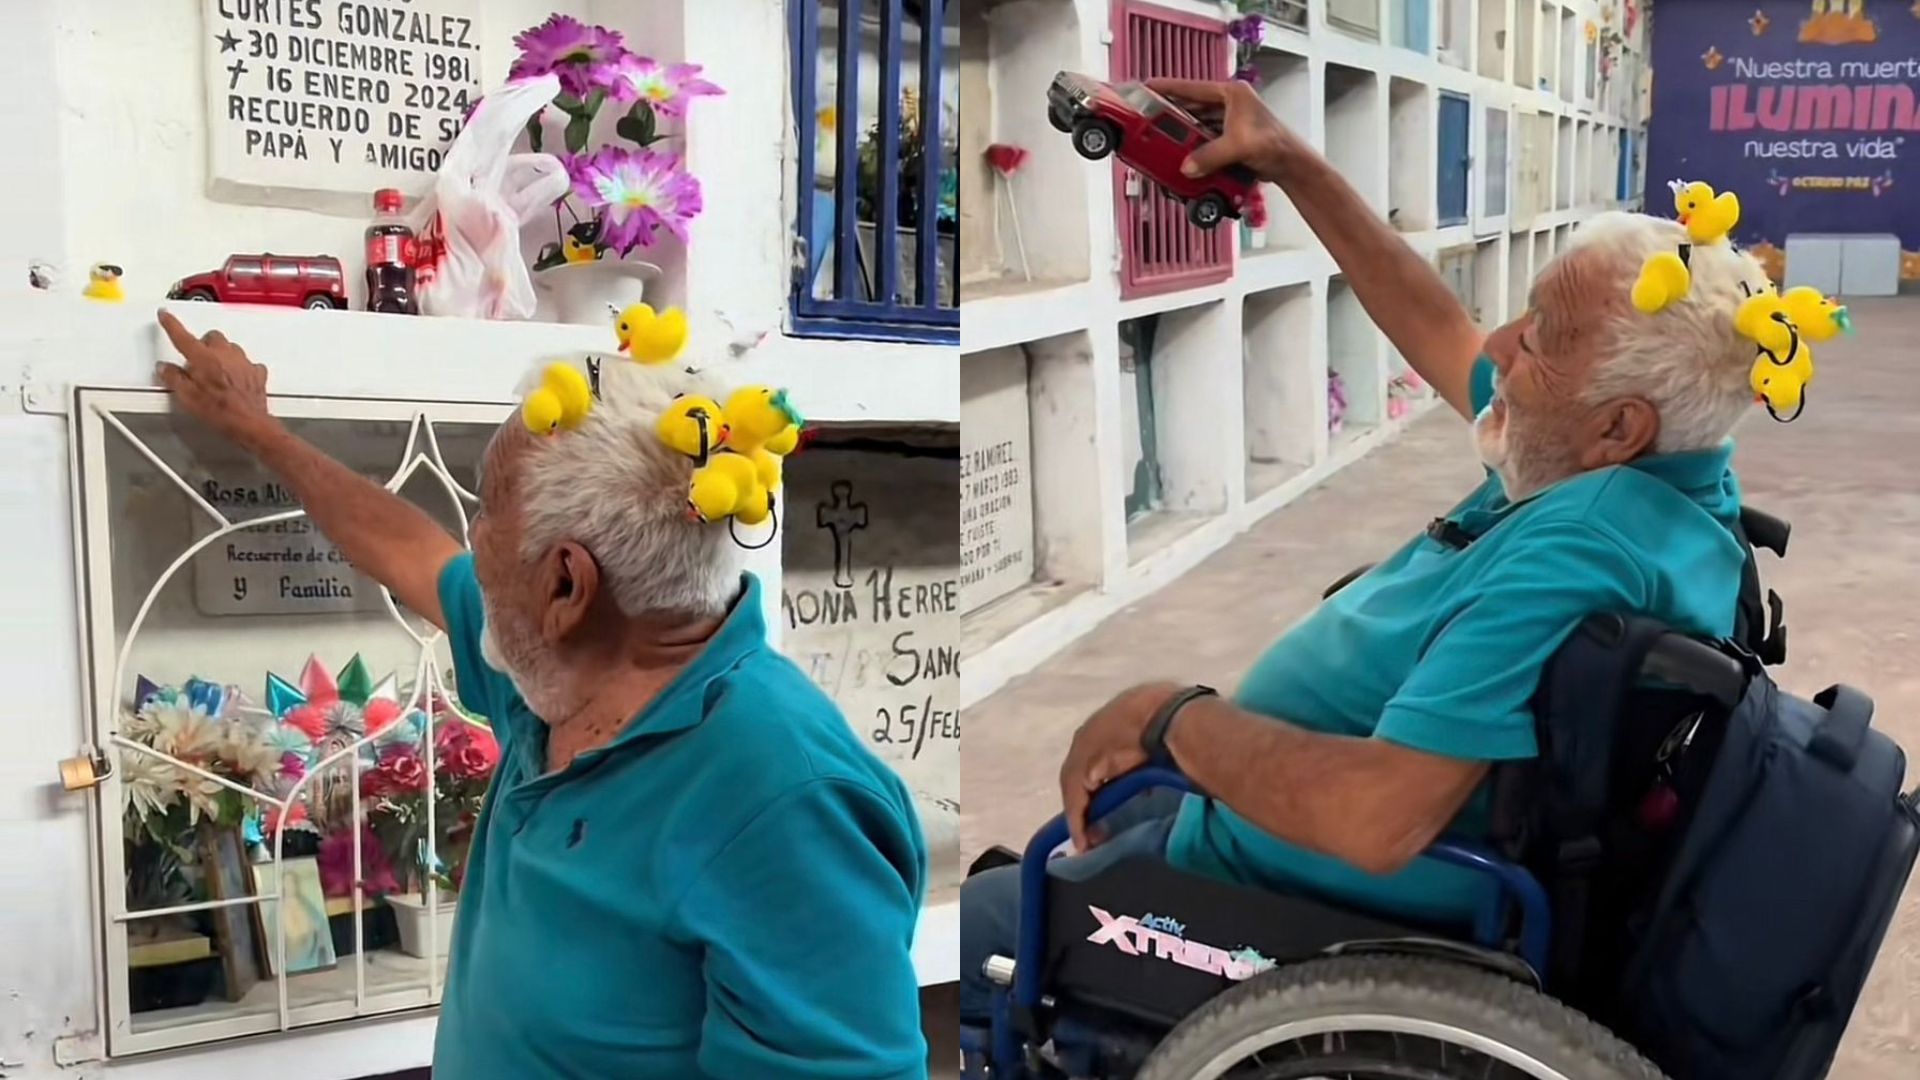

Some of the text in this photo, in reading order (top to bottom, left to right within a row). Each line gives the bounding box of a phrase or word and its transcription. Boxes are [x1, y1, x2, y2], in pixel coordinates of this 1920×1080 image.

[337, 2, 480, 51] GONZALEZ.
[247, 29, 479, 86] 30 DICIEMBRE 1981.
[266, 66, 468, 114] 16 ENERO 2024
[1710, 83, 1920, 132] ILUMIN
[228, 95, 370, 134] RECUERDO
[388, 113, 422, 141] DE
[329, 138, 344, 164] Y
[365, 142, 449, 173] AMIGO
[1744, 138, 1838, 158] nuestra
